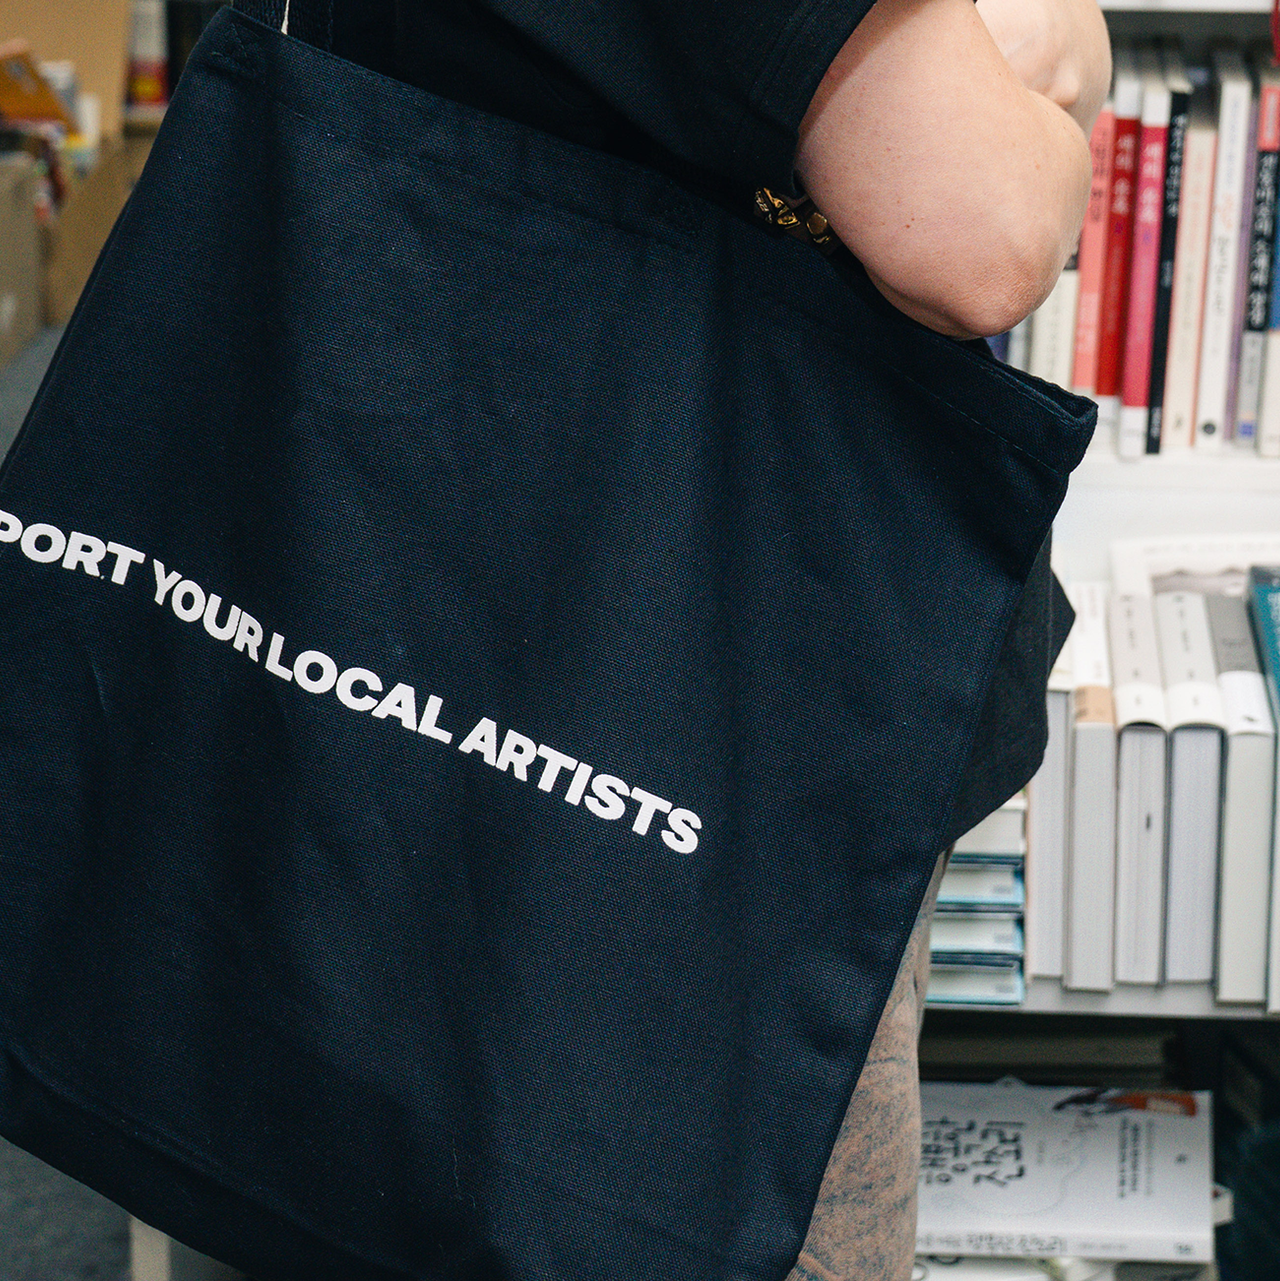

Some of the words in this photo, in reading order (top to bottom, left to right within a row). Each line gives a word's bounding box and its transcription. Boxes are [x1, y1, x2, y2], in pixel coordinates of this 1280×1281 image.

[152, 558, 265, 663] YOUR
[264, 631, 453, 745] LOCAL
[458, 715, 705, 855] ARTISTS
